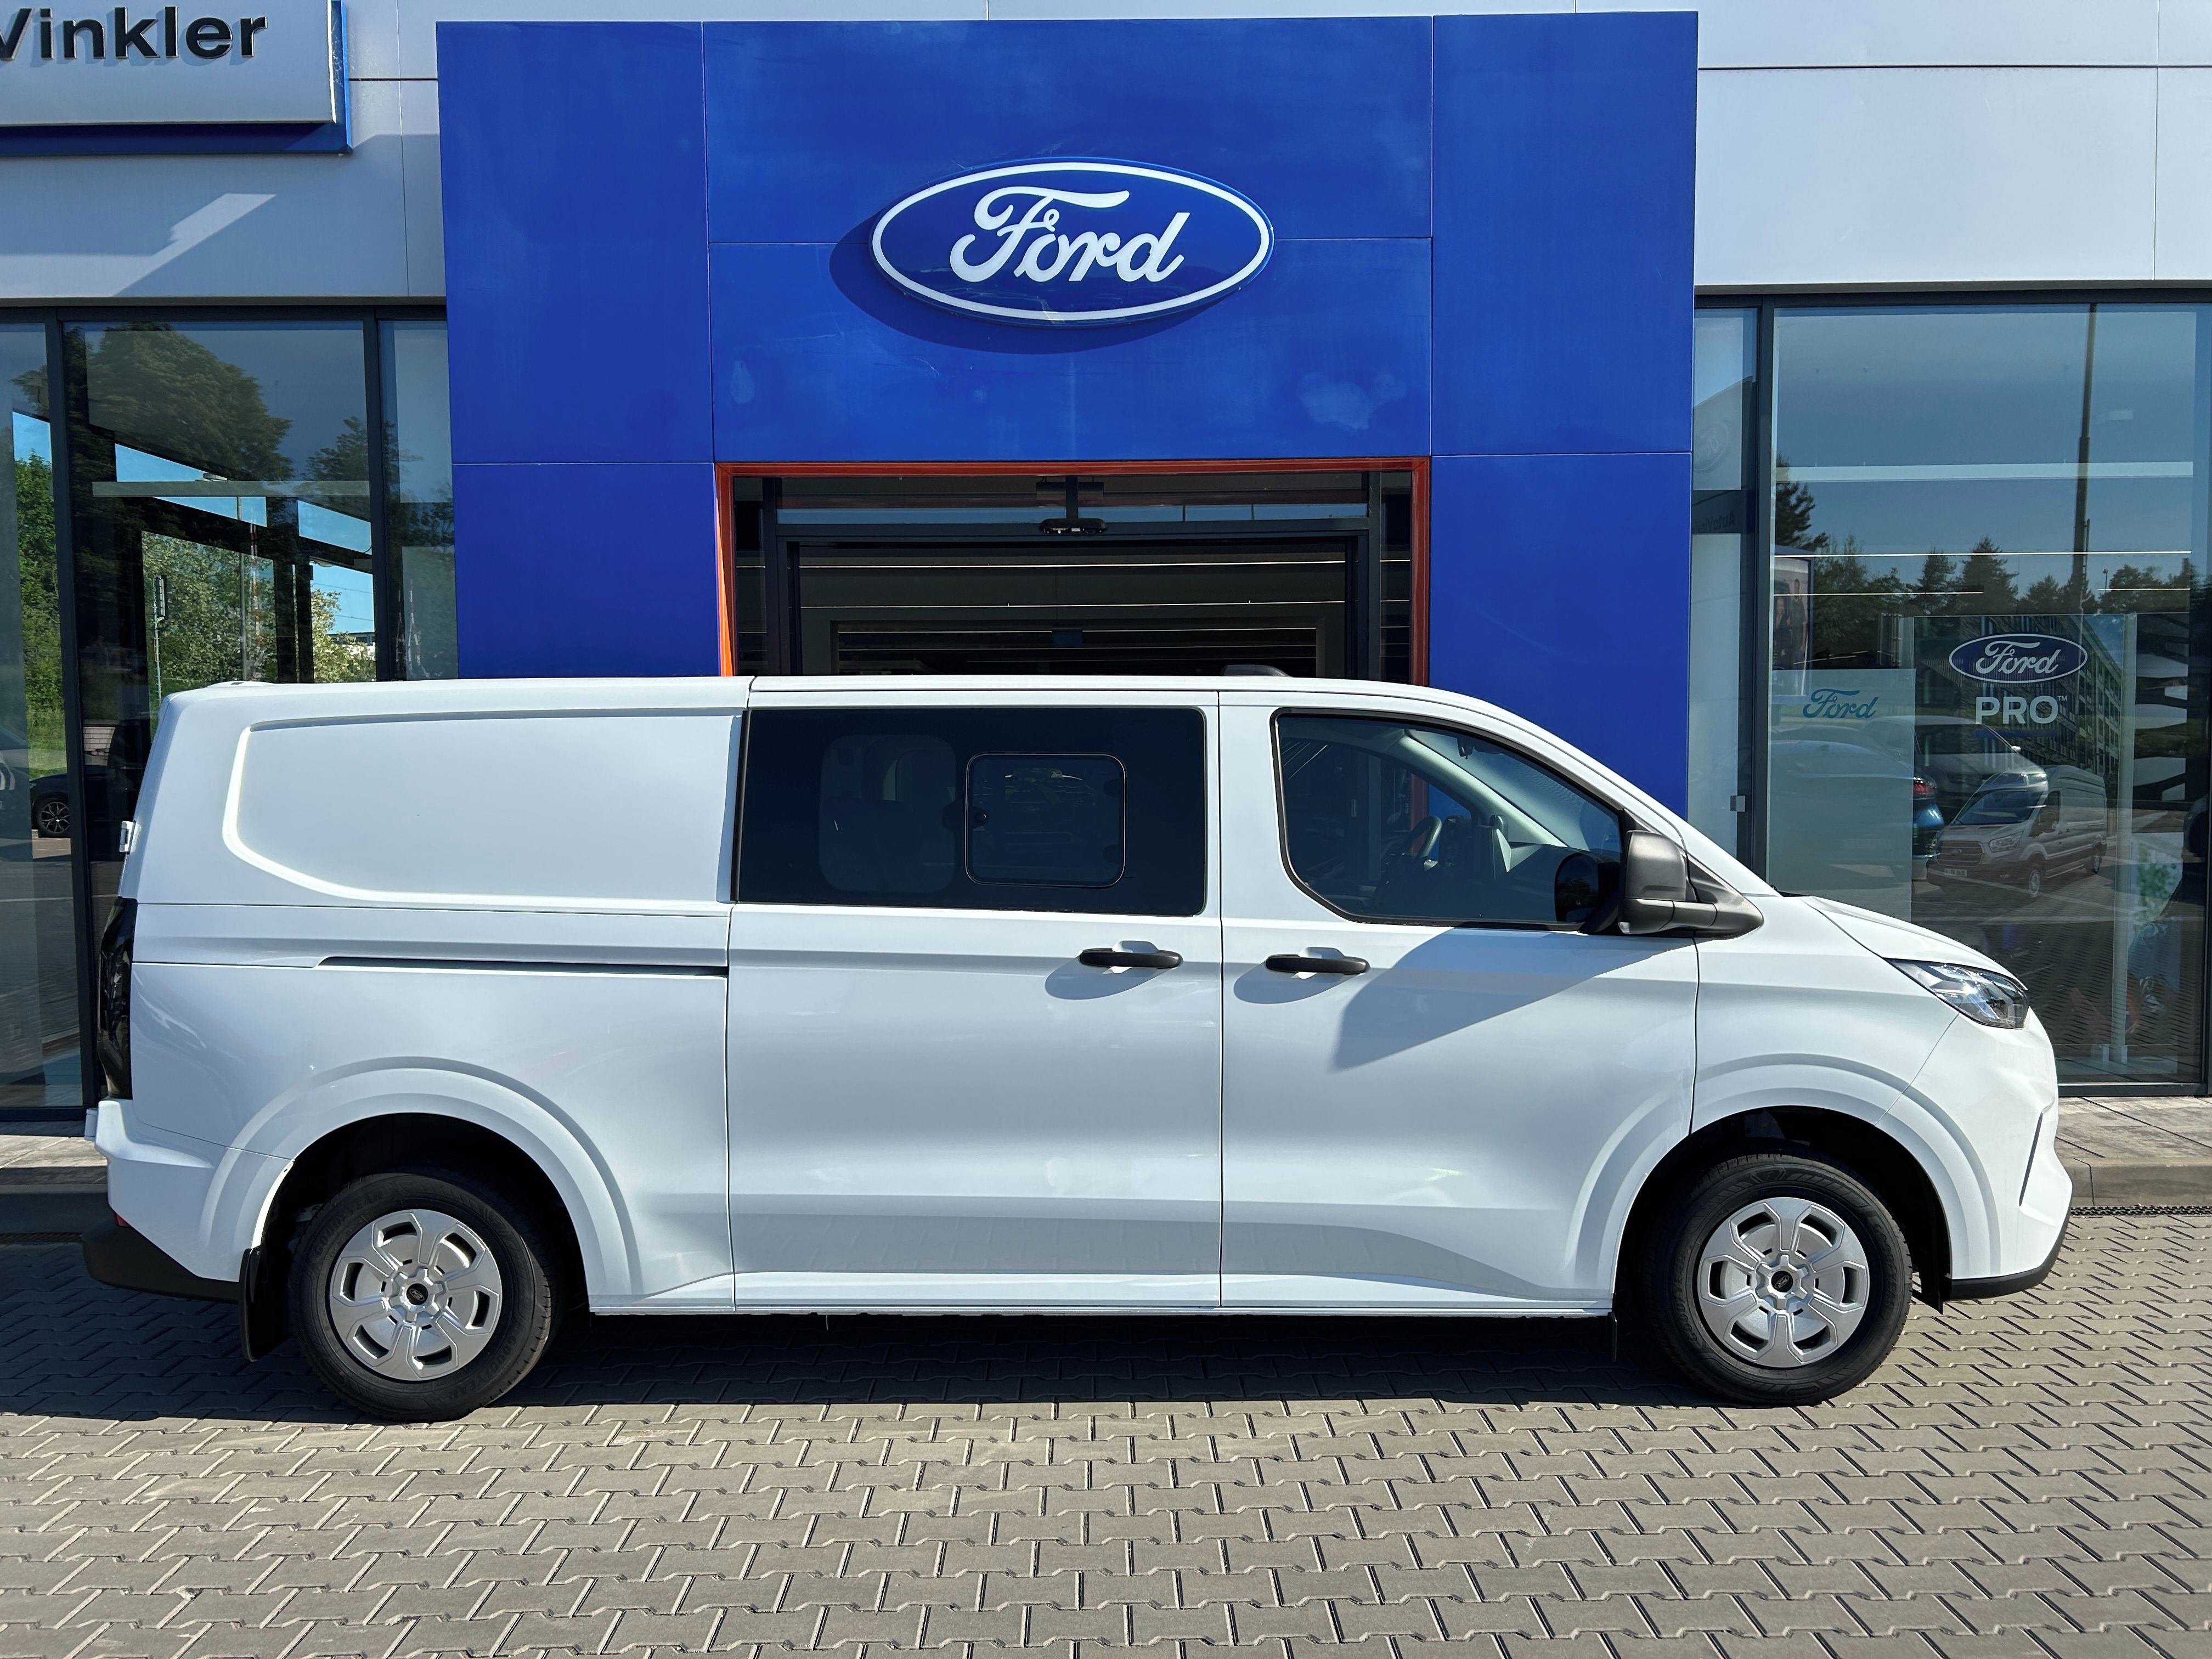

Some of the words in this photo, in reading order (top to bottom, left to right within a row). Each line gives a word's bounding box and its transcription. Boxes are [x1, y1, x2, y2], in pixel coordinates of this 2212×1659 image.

[950, 186, 1190, 283] Ford
[1976, 640, 2061, 675] Ford
[1803, 689, 1879, 719] Ford
[1976, 696, 2058, 725] PRO
